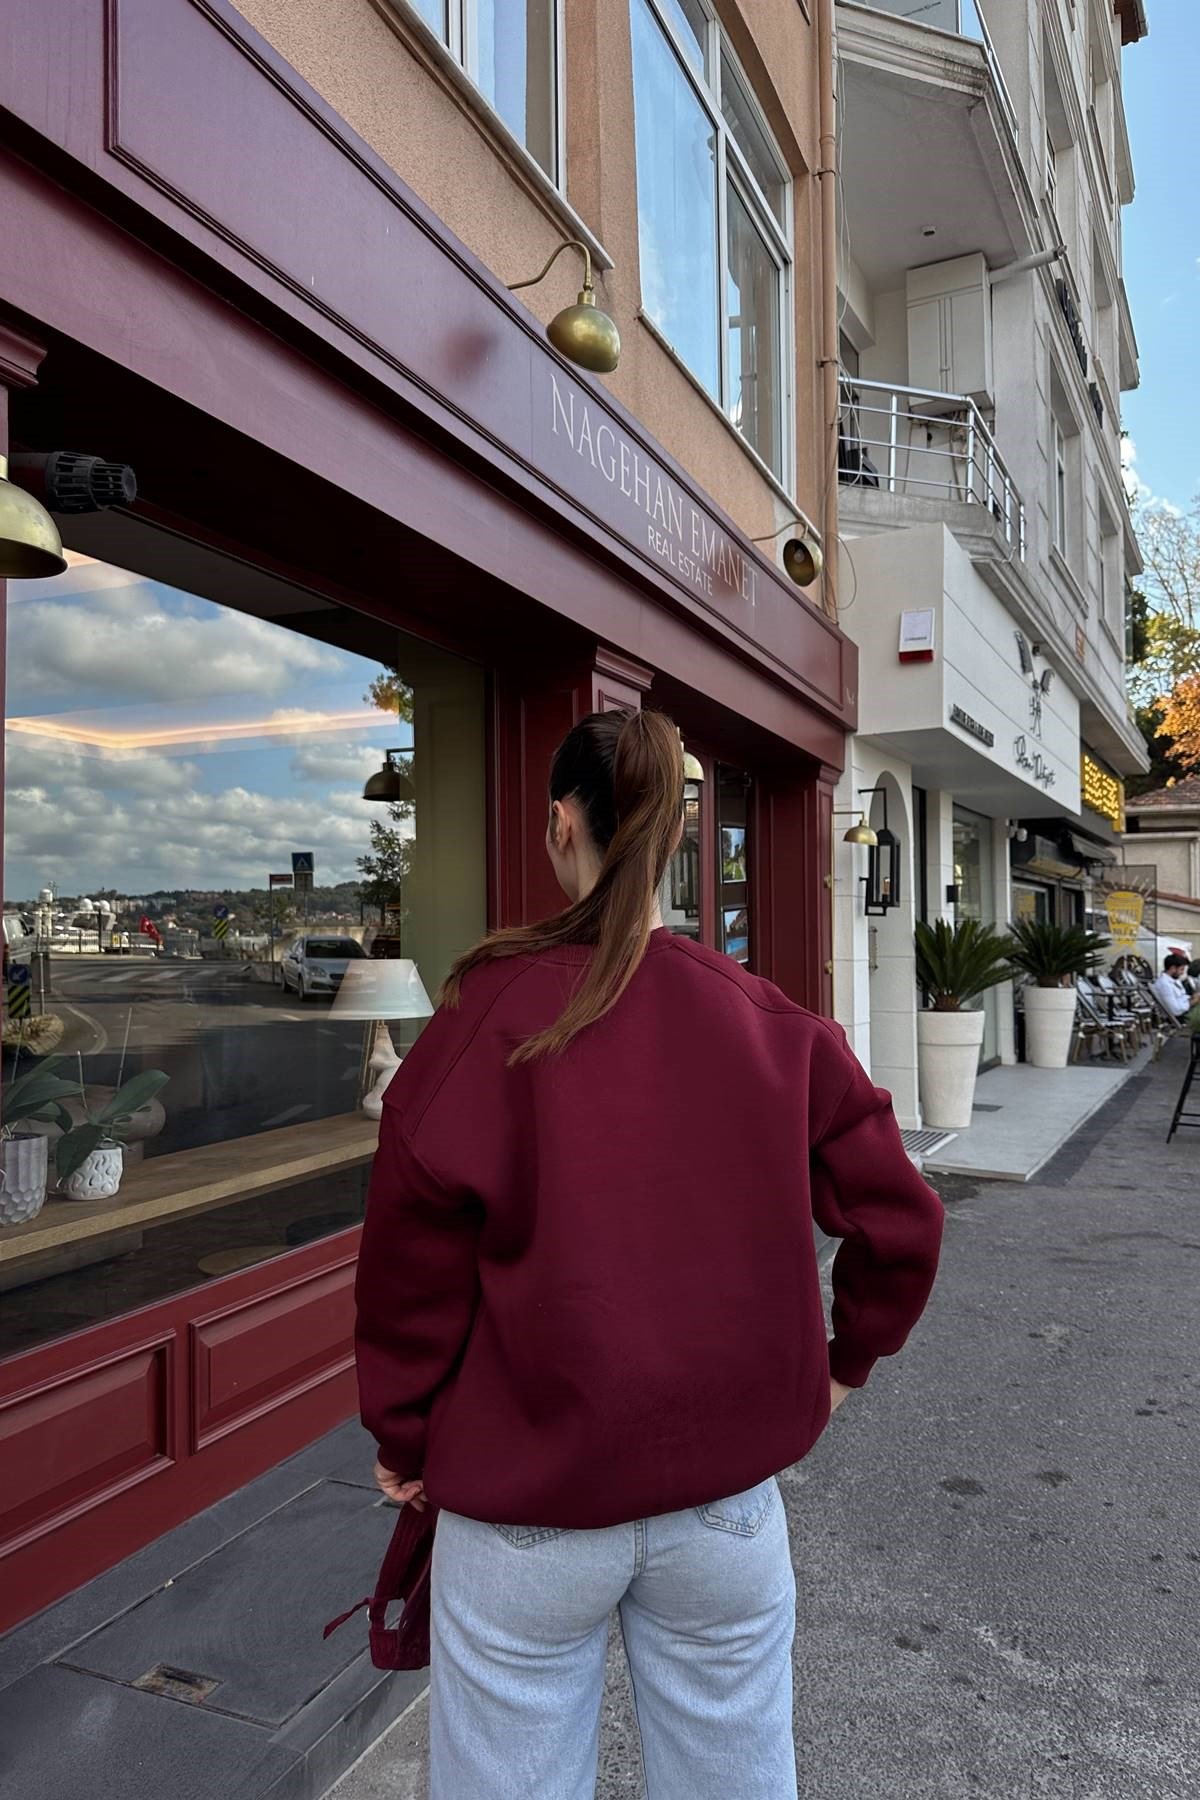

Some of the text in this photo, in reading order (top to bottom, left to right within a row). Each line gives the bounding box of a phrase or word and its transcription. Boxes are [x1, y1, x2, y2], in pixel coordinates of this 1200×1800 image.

[551, 373, 757, 606] NAGEHAN EMANET
[647, 524, 713, 597] REAL ESTATE
